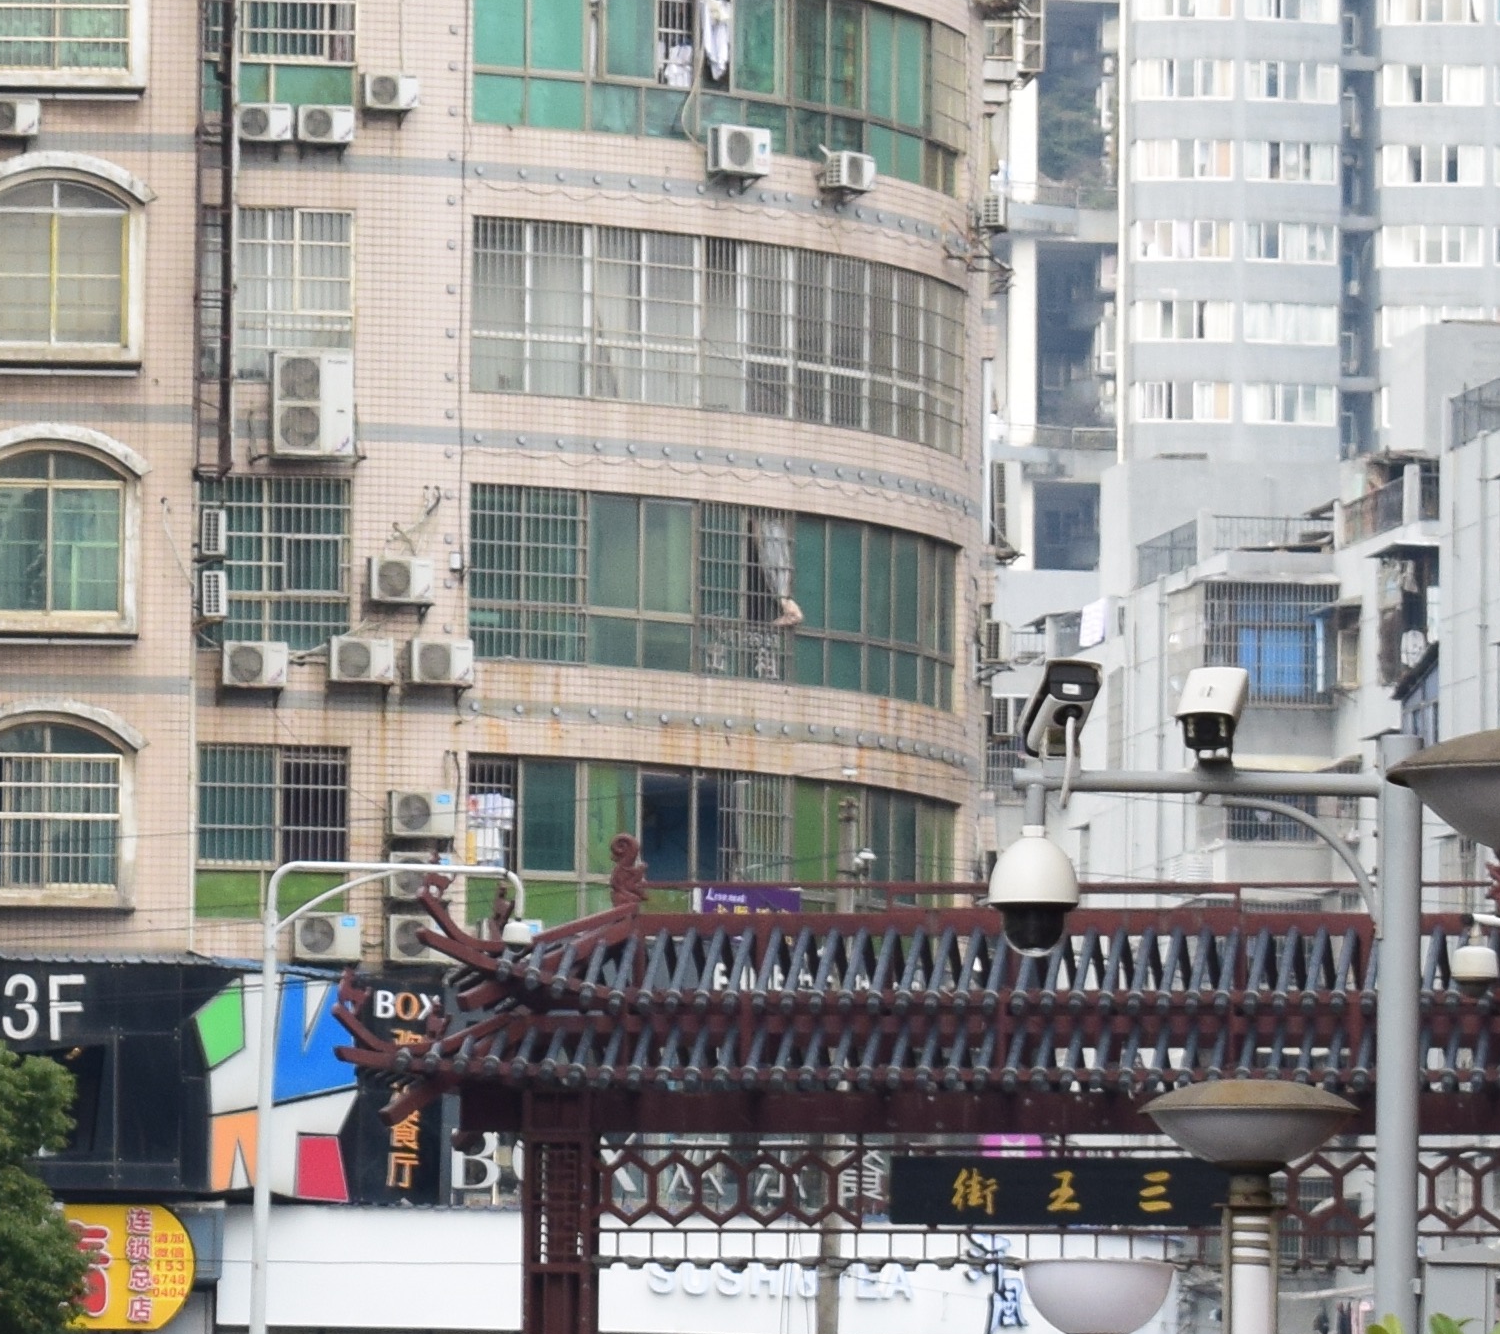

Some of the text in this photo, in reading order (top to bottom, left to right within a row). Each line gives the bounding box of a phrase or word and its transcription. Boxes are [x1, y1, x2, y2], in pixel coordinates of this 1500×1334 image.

[1, 973, 87, 1042] 3F
[127, 1207, 153, 1324] 连锁总店
